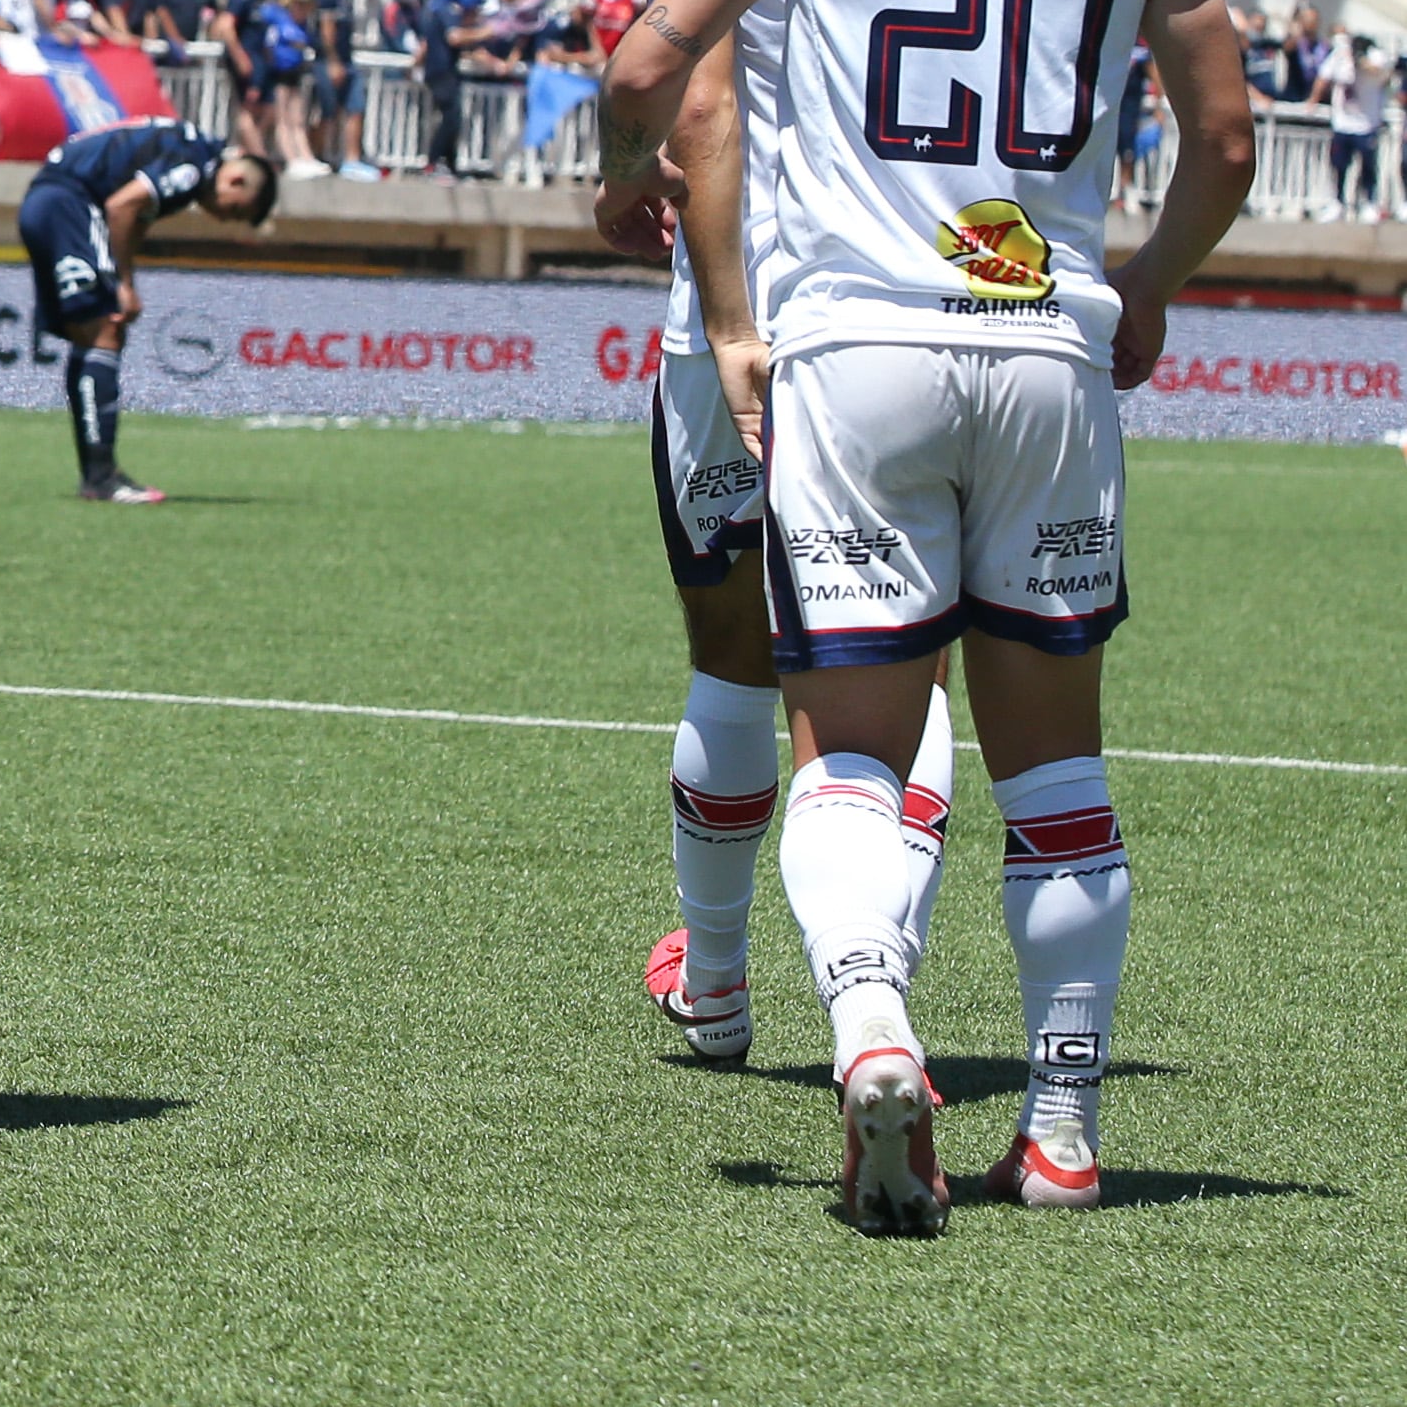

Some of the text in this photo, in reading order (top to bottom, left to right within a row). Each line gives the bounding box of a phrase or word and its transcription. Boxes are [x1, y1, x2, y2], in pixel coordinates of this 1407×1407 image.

[941, 297, 1060, 319] TRAINING
[240, 330, 535, 372] GAC MOTOR
[1151, 355, 1401, 400] GAC MOTOR
[785, 528, 899, 544] WORLD
[790, 542, 902, 565] FAST
[701, 1025, 747, 1041] TIEMPO
